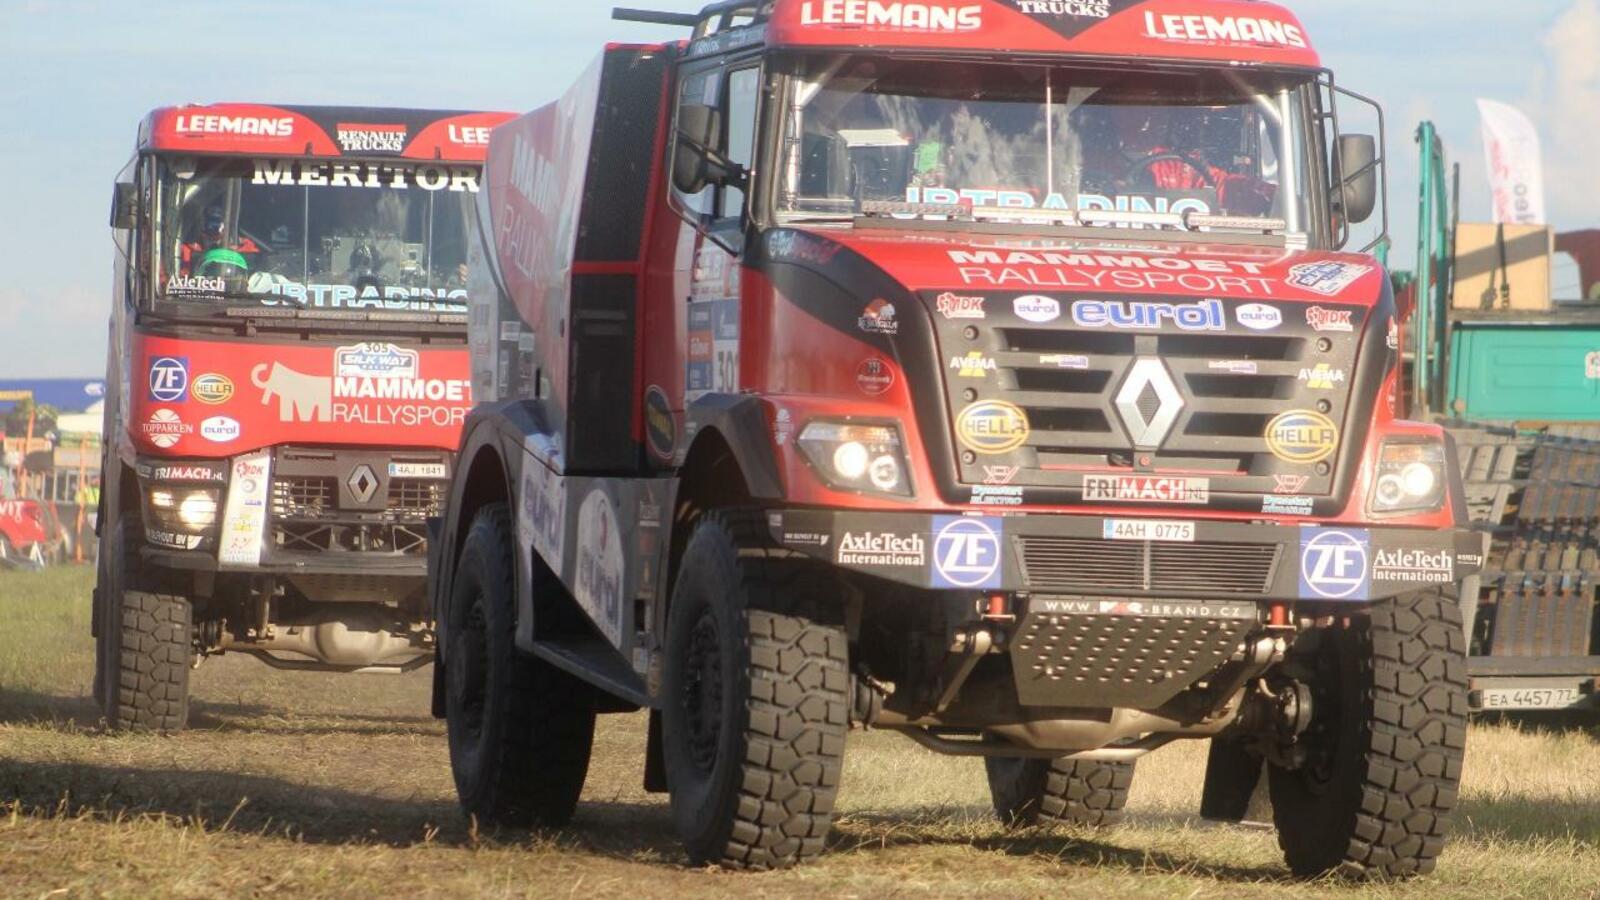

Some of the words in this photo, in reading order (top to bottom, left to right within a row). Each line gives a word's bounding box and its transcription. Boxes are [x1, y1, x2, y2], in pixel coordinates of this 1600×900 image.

[801, 1, 982, 30] LEEMANS
[1016, 0, 1110, 18] TRUCKS
[1144, 11, 1306, 48] LEEMANS
[176, 115, 293, 136] LEEMANS
[338, 131, 407, 142] RENAULT
[341, 140, 402, 151] TRUCKS
[947, 250, 1264, 274] MAMMOET
[959, 266, 1277, 294] RALLYSPORT
[1018, 304, 1056, 313] eurol
[1074, 299, 1224, 329] eurol
[1240, 307, 1279, 321] eurol
[950, 356, 996, 370] AVEMA
[1298, 368, 1344, 381] AVEMA
[196, 384, 232, 394] HELLA
[143, 423, 193, 434] TOPPARKEN
[204, 425, 237, 434] eurol
[964, 417, 1026, 437] HELLA
[1274, 427, 1335, 445] HELLA
[1115, 522, 1146, 537] 4AH
[1155, 523, 1190, 539] 0775
[839, 531, 924, 551] AxleTech
[838, 552, 925, 566] International
[936, 532, 998, 573] ZF
[1373, 549, 1452, 568] AxleTech
[1304, 544, 1364, 583] ZF
[1372, 568, 1452, 582] International
[1489, 694, 1508, 706] EA
[1513, 690, 1552, 706] 4457
[1555, 689, 1573, 701] 77
